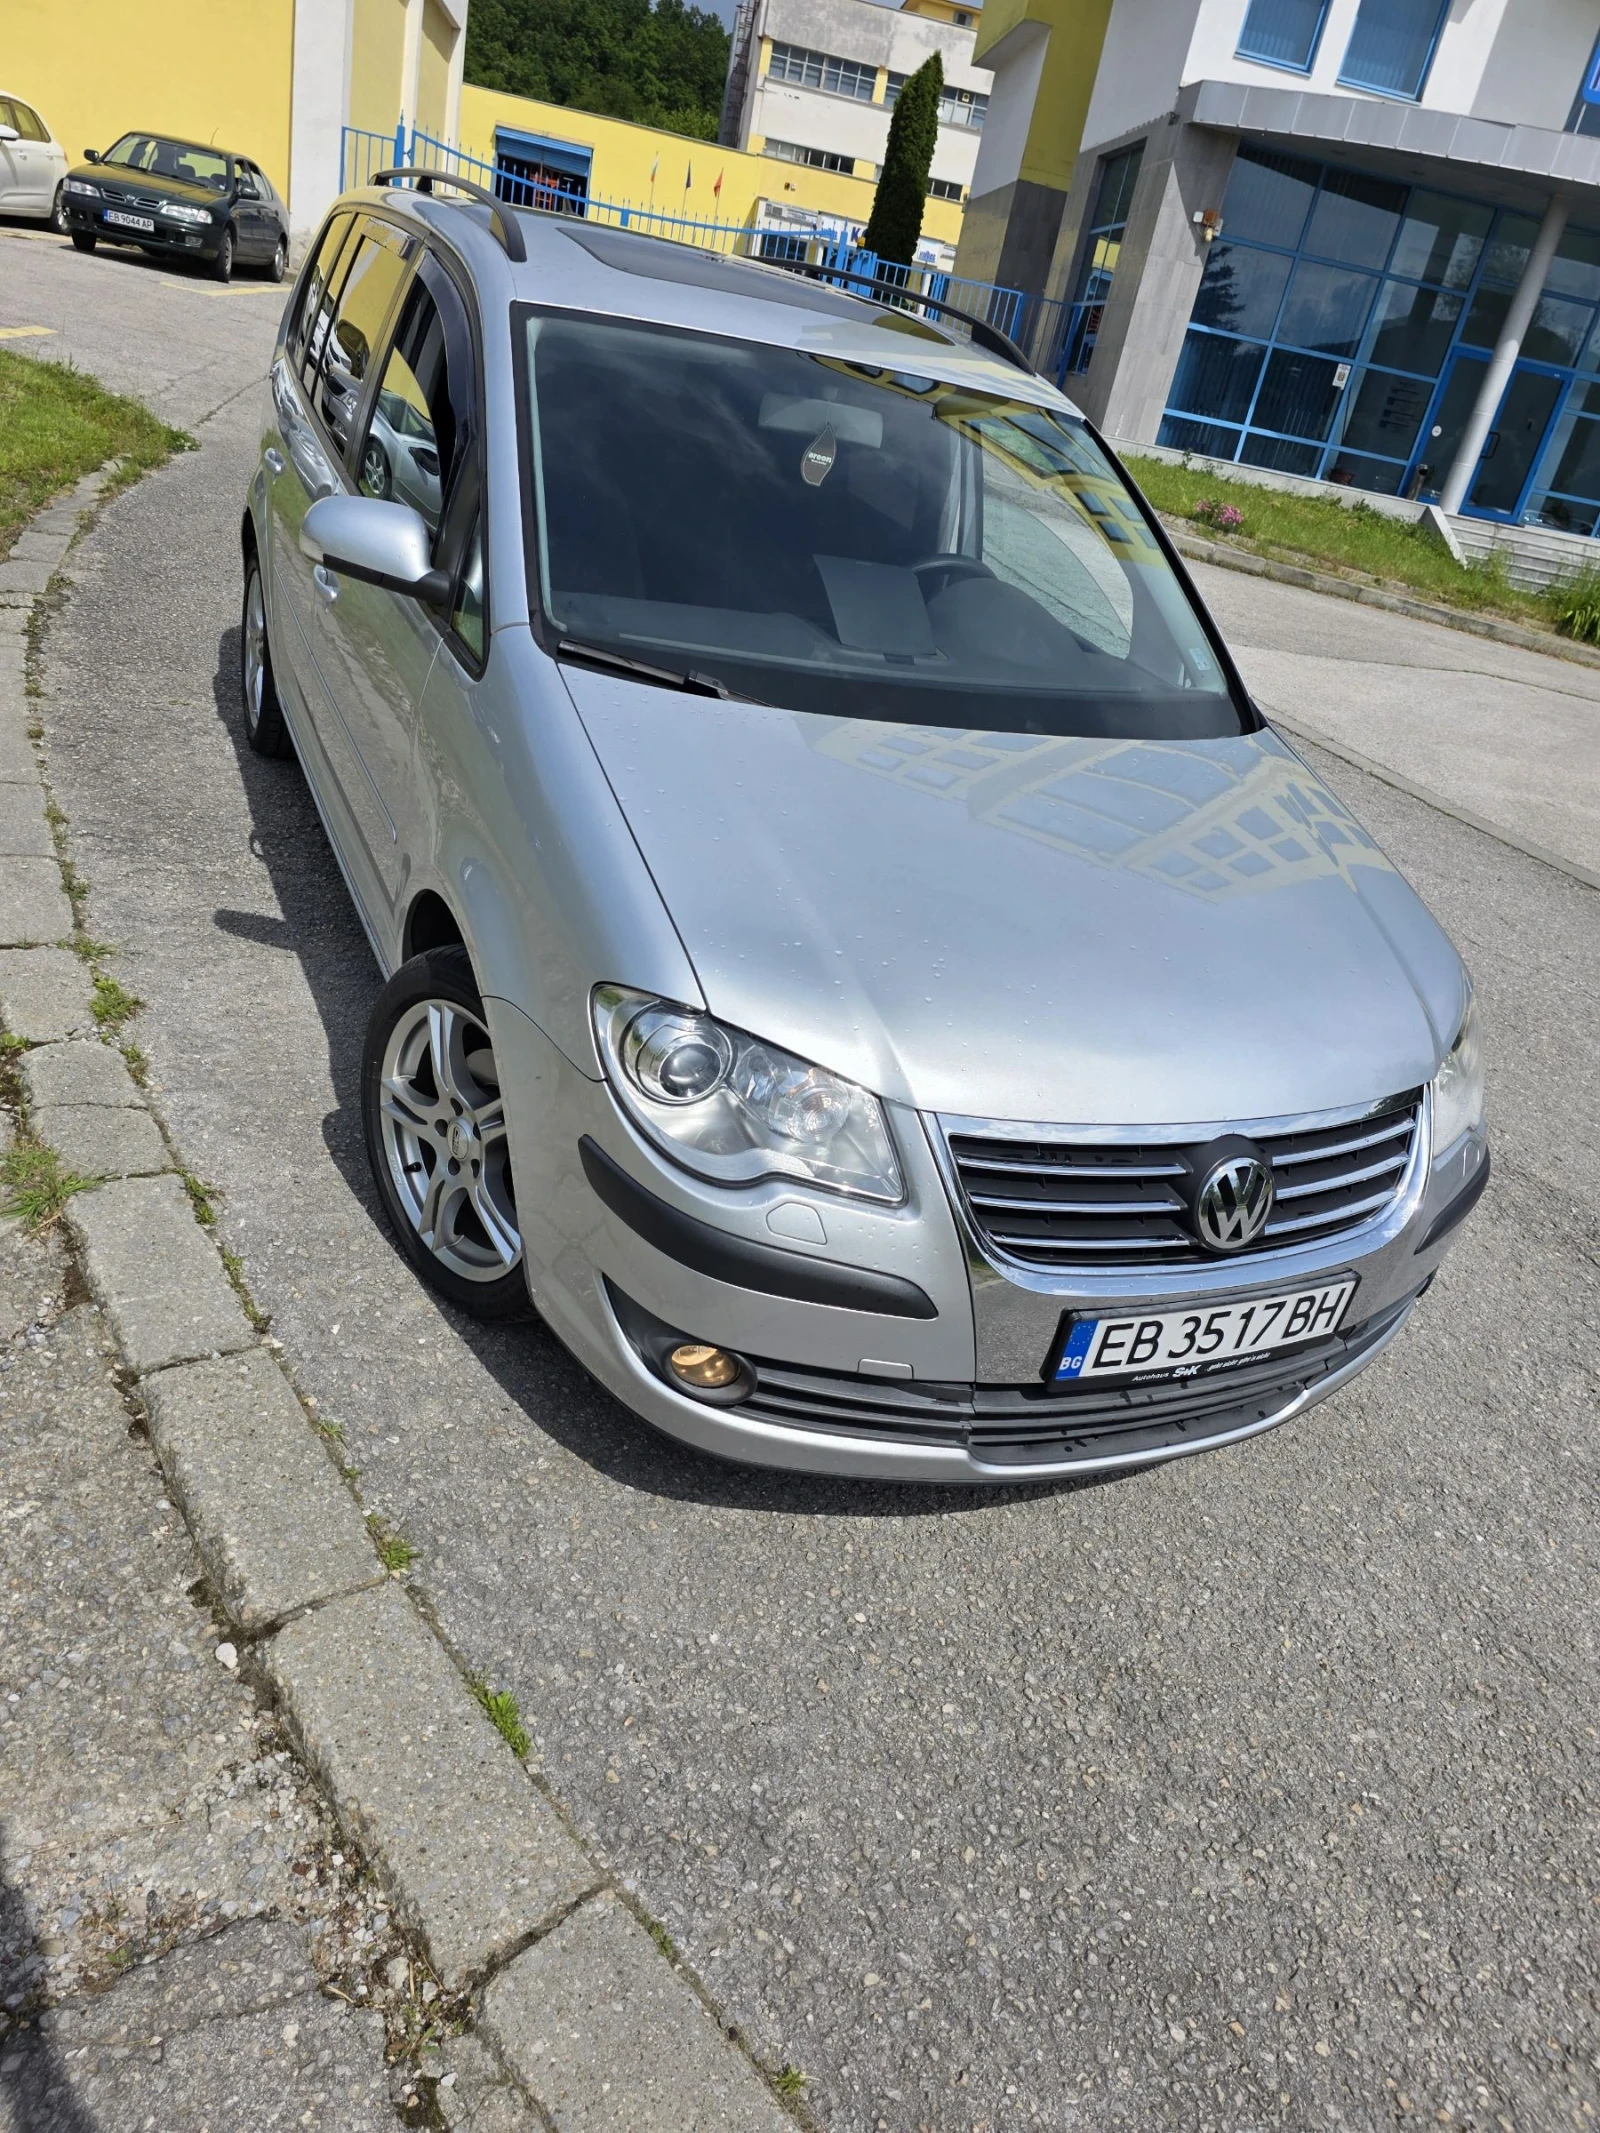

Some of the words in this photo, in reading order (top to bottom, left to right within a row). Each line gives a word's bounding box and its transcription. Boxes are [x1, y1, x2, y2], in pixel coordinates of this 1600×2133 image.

[109, 212, 119, 222] EB
[121, 215, 140, 226] 9044
[142, 220, 152, 228] AP
[1092, 1320, 1163, 1369] EB
[1167, 1300, 1287, 1358] 3517
[1282, 1287, 1347, 1339] BH
[1059, 1355, 1083, 1371] BG
[1131, 1372, 1170, 1382] Autohaus
